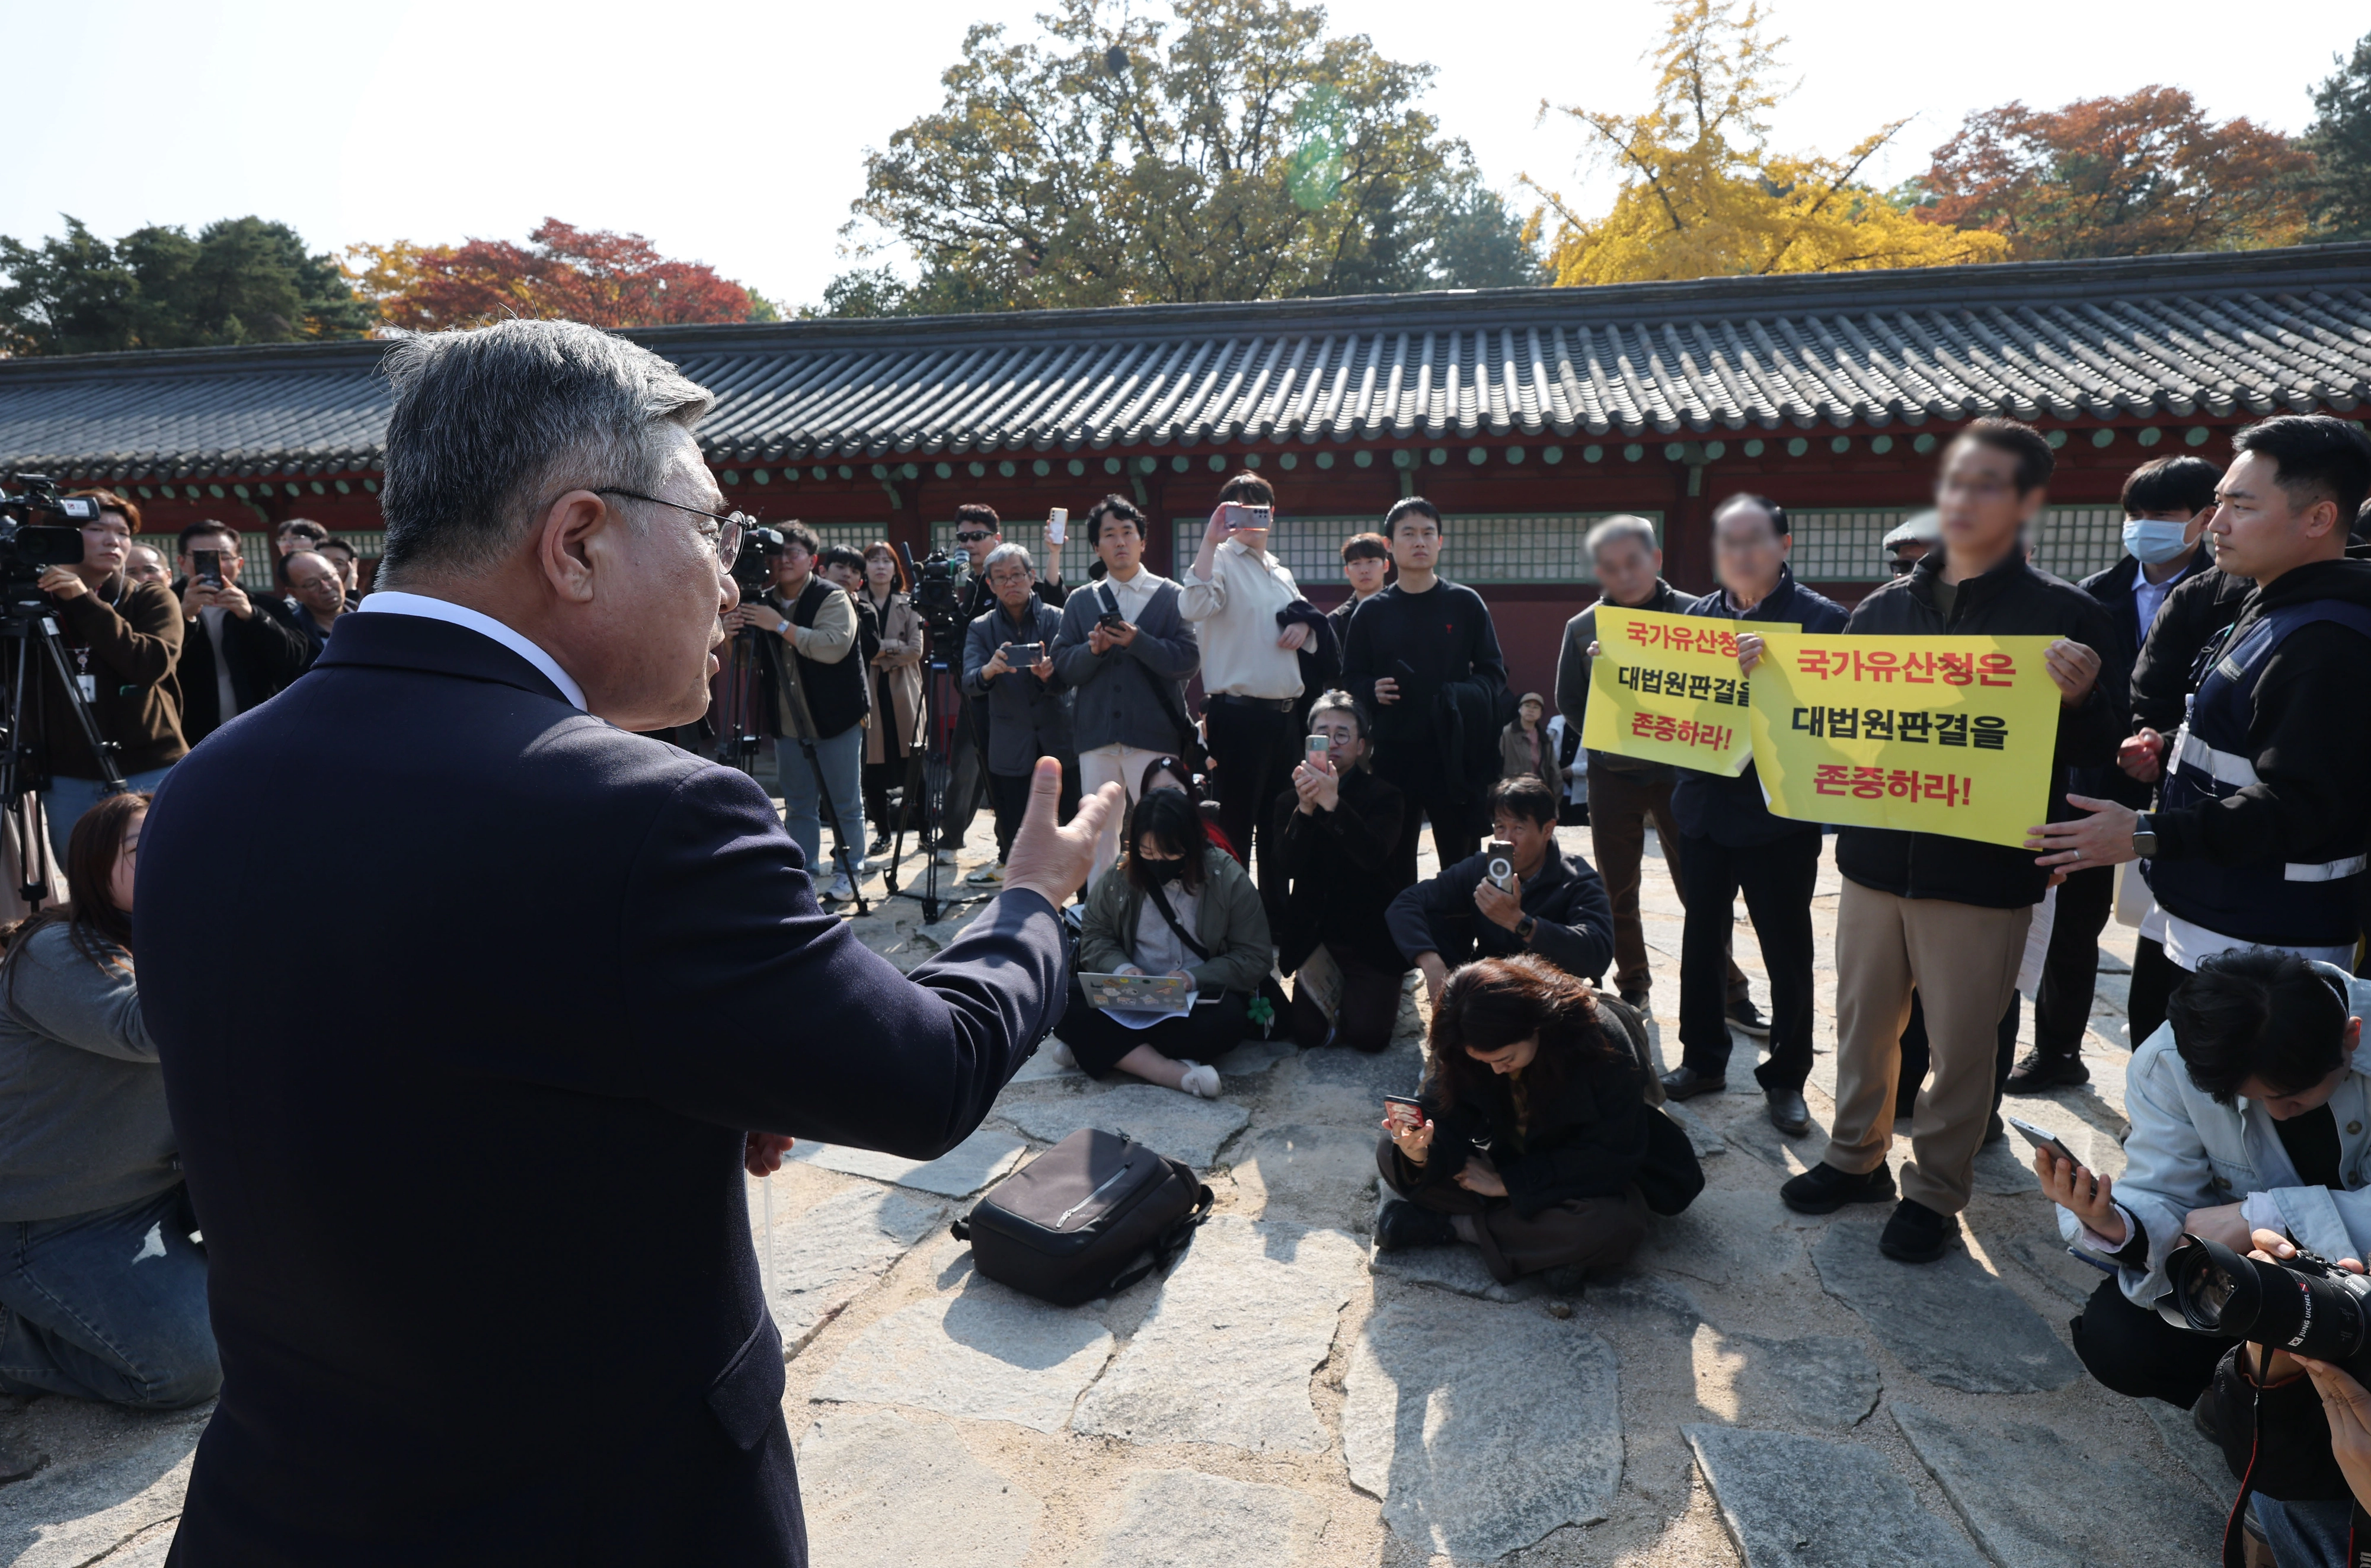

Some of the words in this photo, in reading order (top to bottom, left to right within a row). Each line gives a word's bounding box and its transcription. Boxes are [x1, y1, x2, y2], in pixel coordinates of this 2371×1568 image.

[1627, 621, 1739, 658] 국가유산청
[1797, 649, 2016, 687] 국가유산청은
[1632, 712, 1733, 751] 존중하라!
[1792, 706, 2008, 750] 대법원판결을
[1814, 764, 1971, 808] 존중하라!
[2345, 1279, 2366, 1295] Canon
[2299, 1320, 2310, 1337] JUNG
